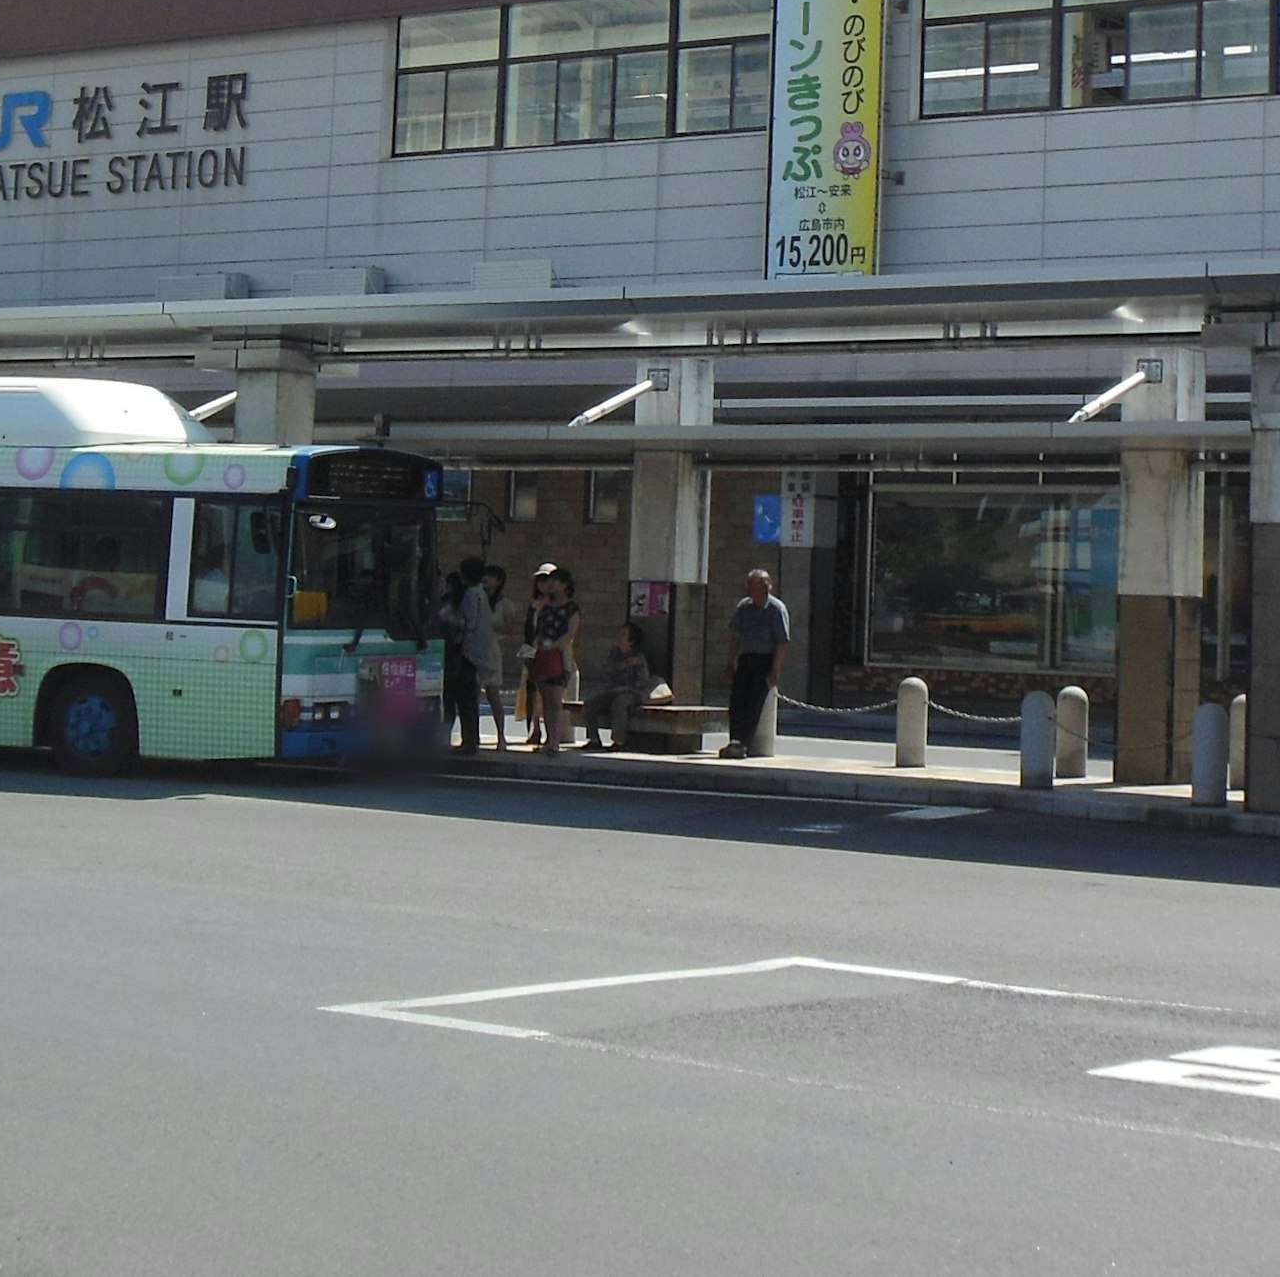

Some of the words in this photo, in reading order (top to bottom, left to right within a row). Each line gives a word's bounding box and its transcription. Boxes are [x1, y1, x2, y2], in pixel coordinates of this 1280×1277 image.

[72, 72, 249, 144] 松江駅
[106, 146, 247, 194] STATION
[799, 218, 845, 232] 広島市内
[775, 234, 866, 273] 15,200円
